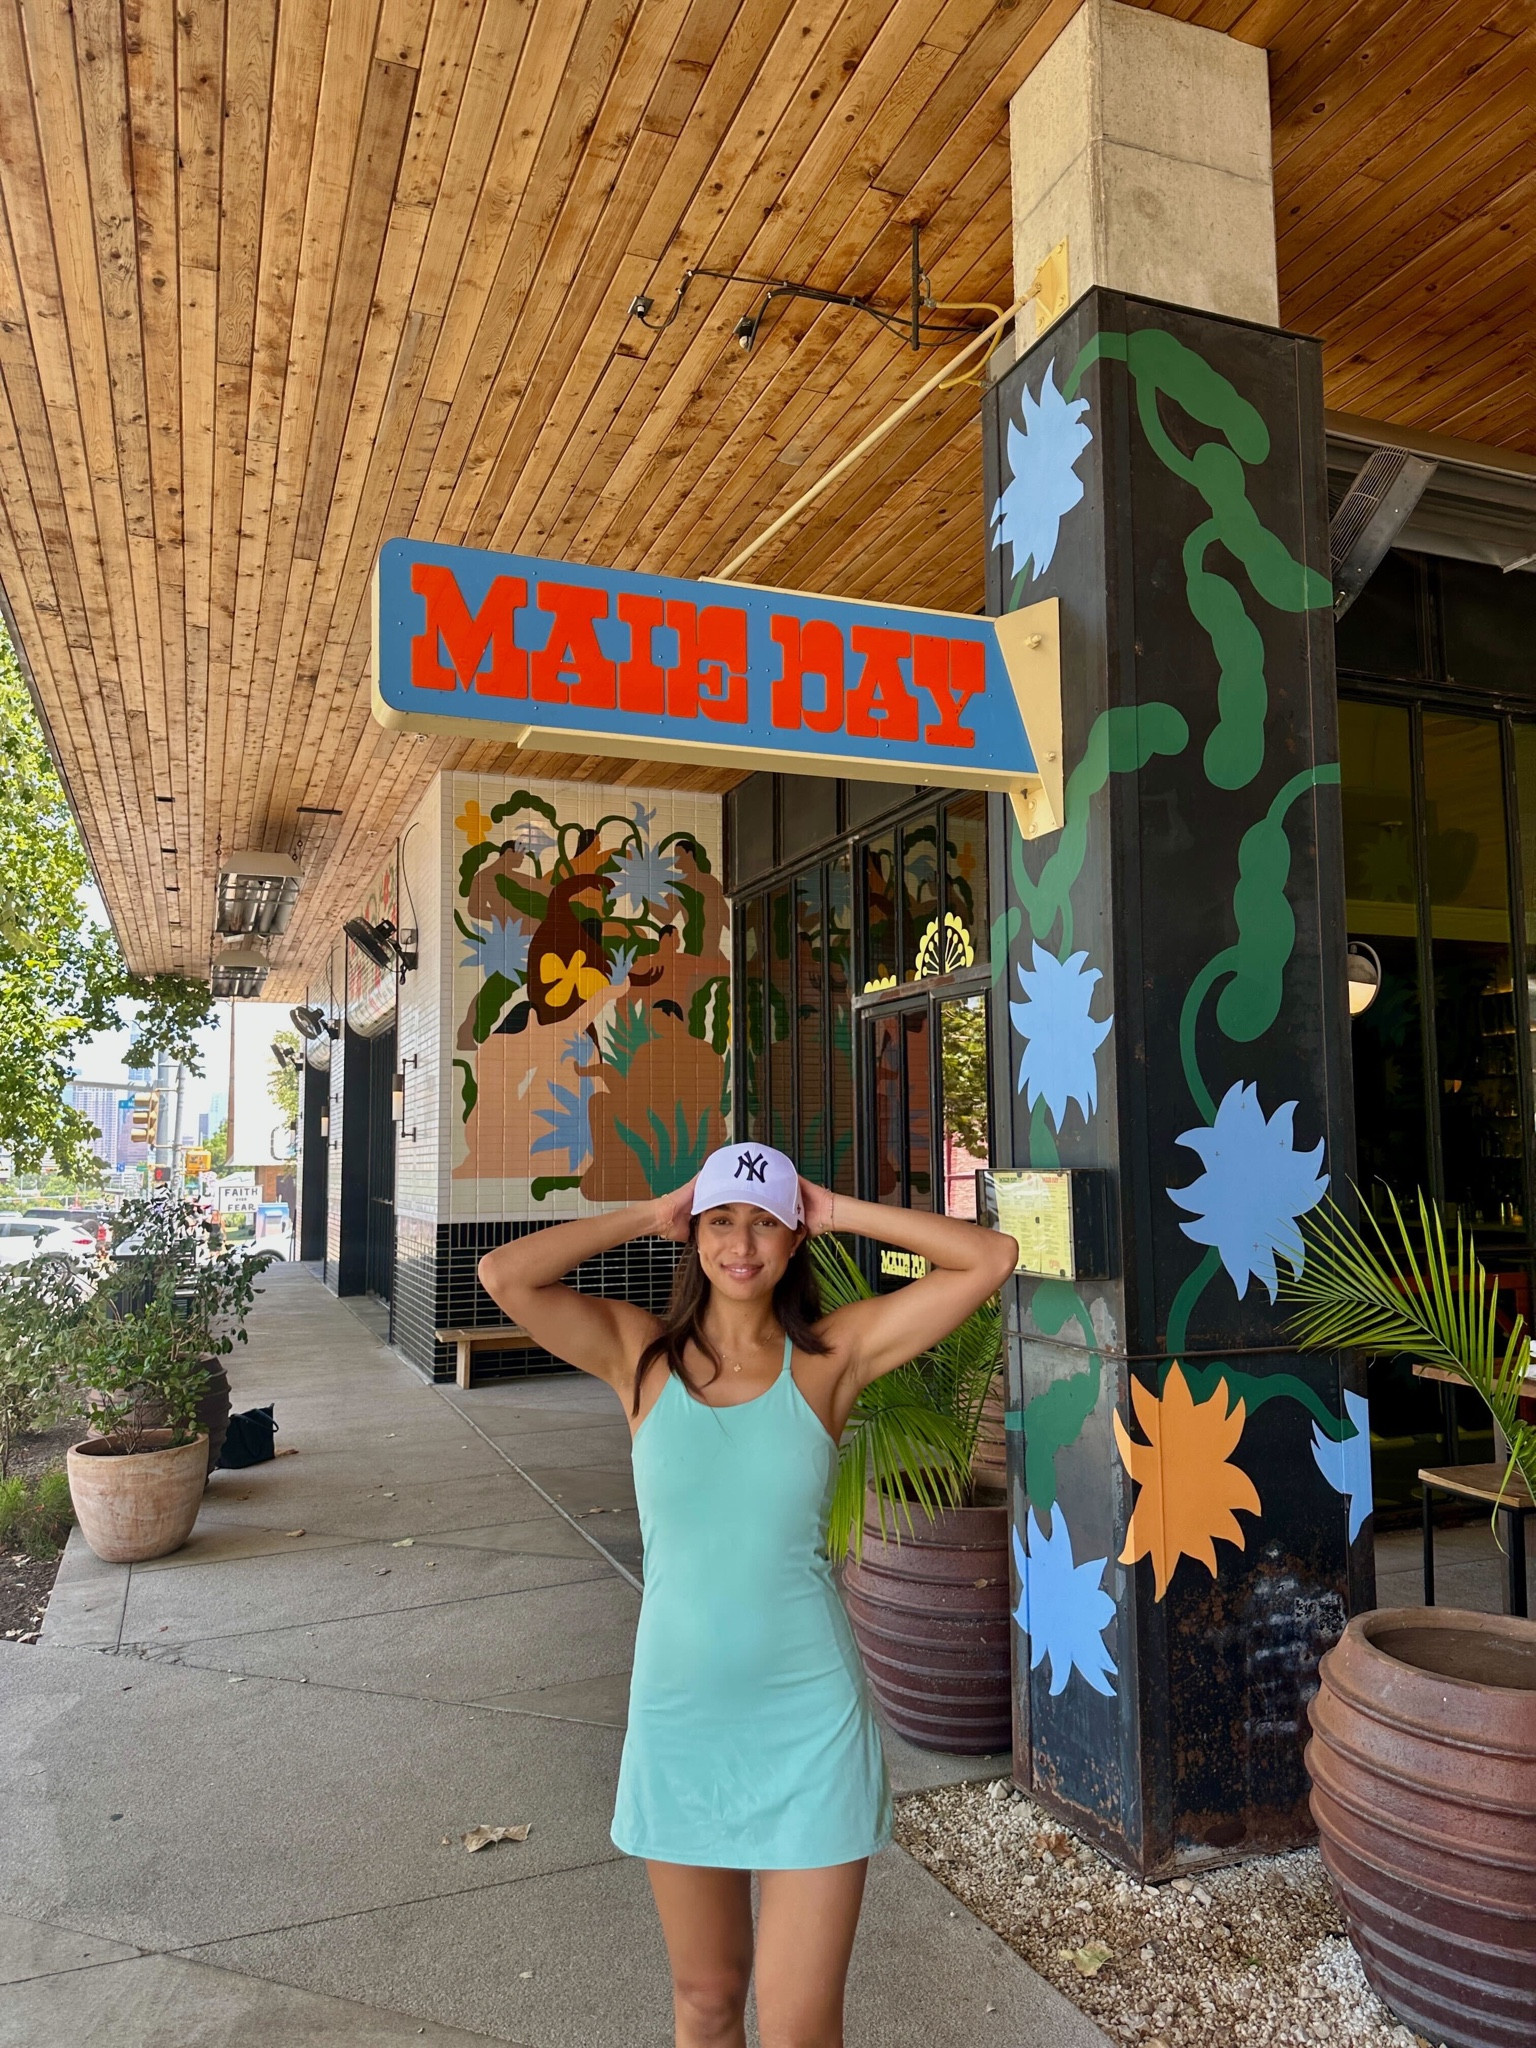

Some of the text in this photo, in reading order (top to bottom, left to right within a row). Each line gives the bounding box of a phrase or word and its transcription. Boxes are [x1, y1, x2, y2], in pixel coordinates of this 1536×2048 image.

[411, 562, 986, 749] MAIE DAY
[734, 1150, 769, 1184] NY
[224, 1187, 258, 1197] FAITH
[227, 1203, 256, 1212] FEAR
[911, 1254, 927, 1279] DA
